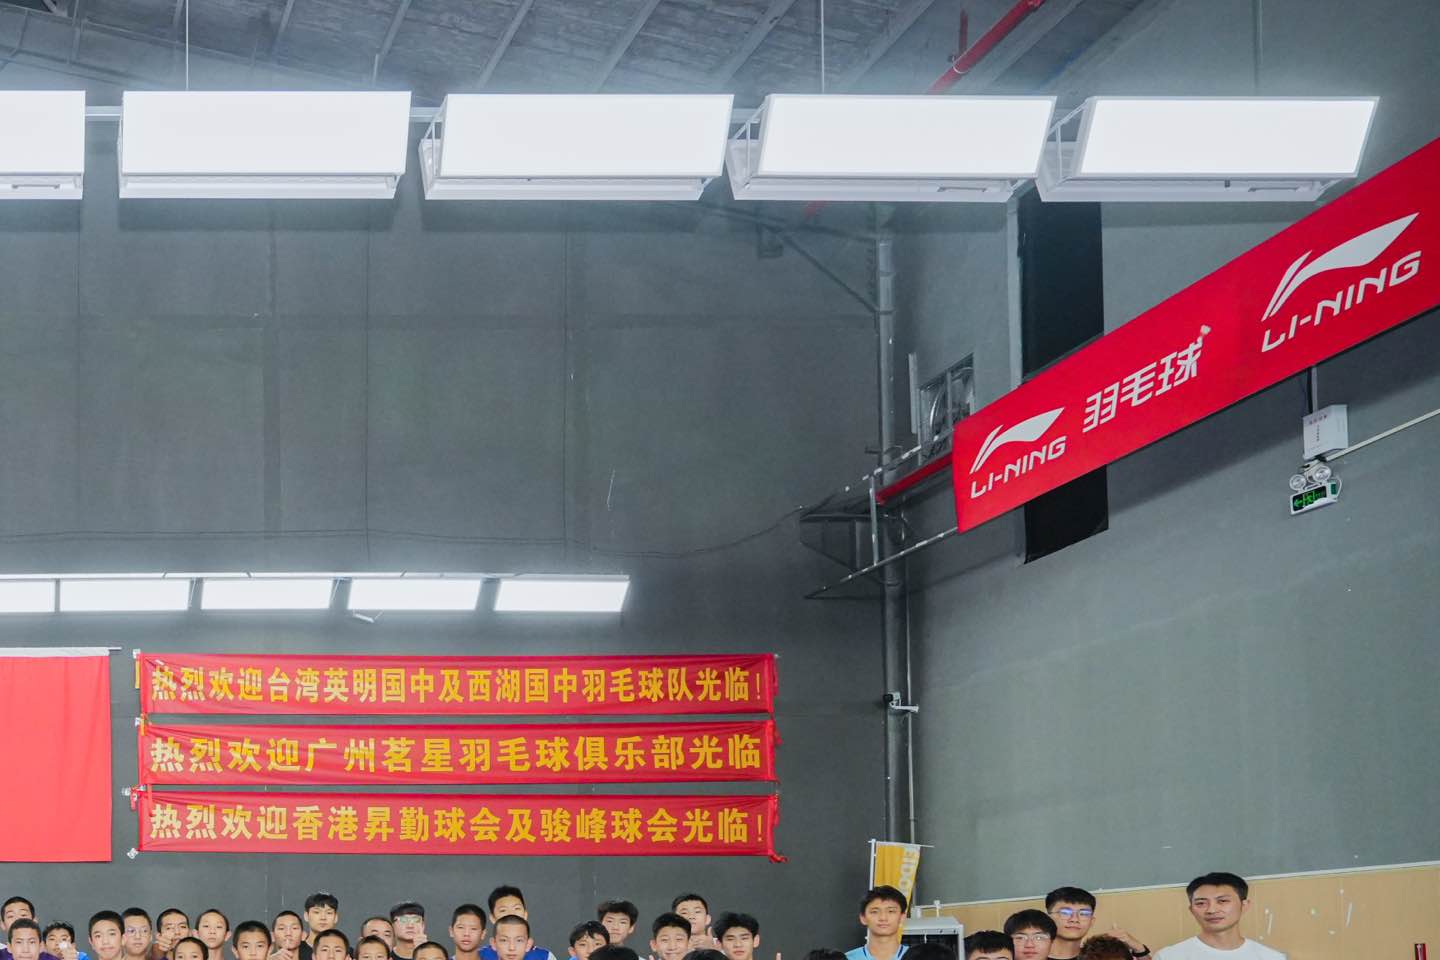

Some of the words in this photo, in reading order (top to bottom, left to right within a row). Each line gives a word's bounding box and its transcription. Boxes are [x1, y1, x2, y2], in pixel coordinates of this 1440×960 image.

[1261, 250, 1422, 353] LI-NING
[970, 436, 1067, 499] LI-NING
[1082, 325, 1211, 433] 羽毛球
[150, 734, 761, 773] 热烈欢迎广州茗星羽毛球俱乐部光临
